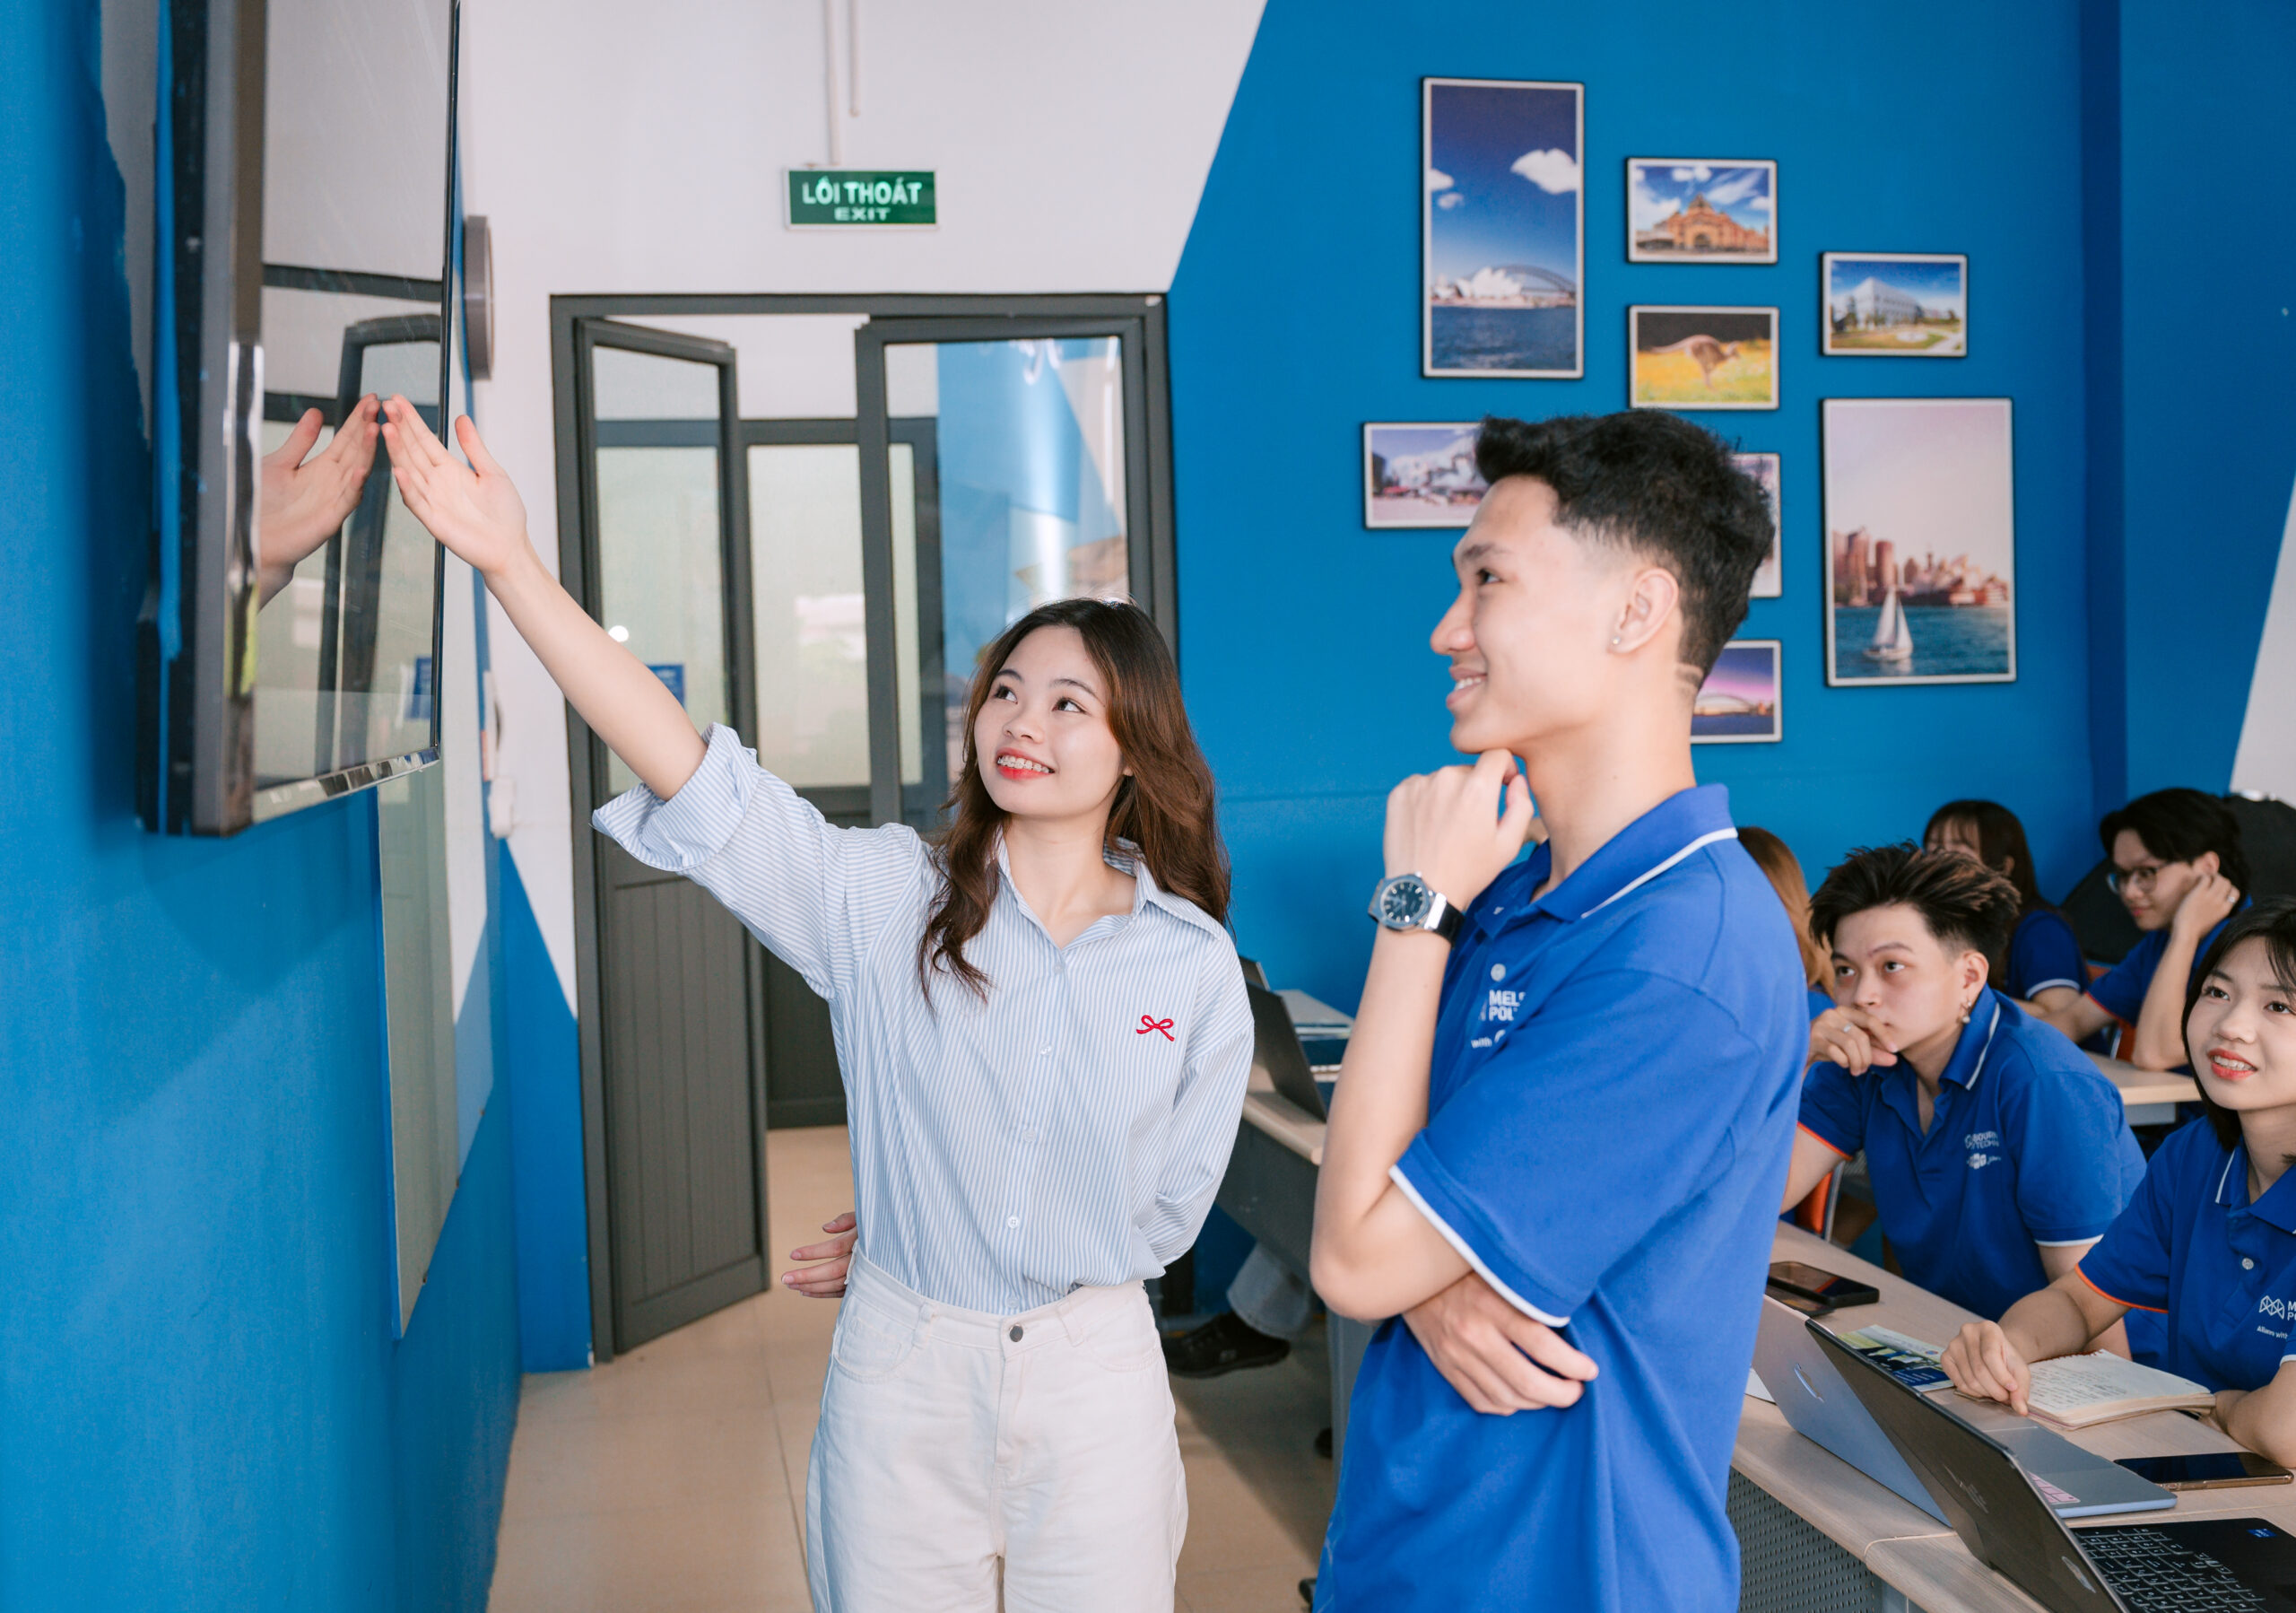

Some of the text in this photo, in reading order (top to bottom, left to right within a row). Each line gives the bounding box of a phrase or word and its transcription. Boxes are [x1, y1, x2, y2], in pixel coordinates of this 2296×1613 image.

[843, 176, 923, 205] THOÁT
[833, 206, 891, 222] EXIT
[1489, 1006, 1518, 1021] POL
